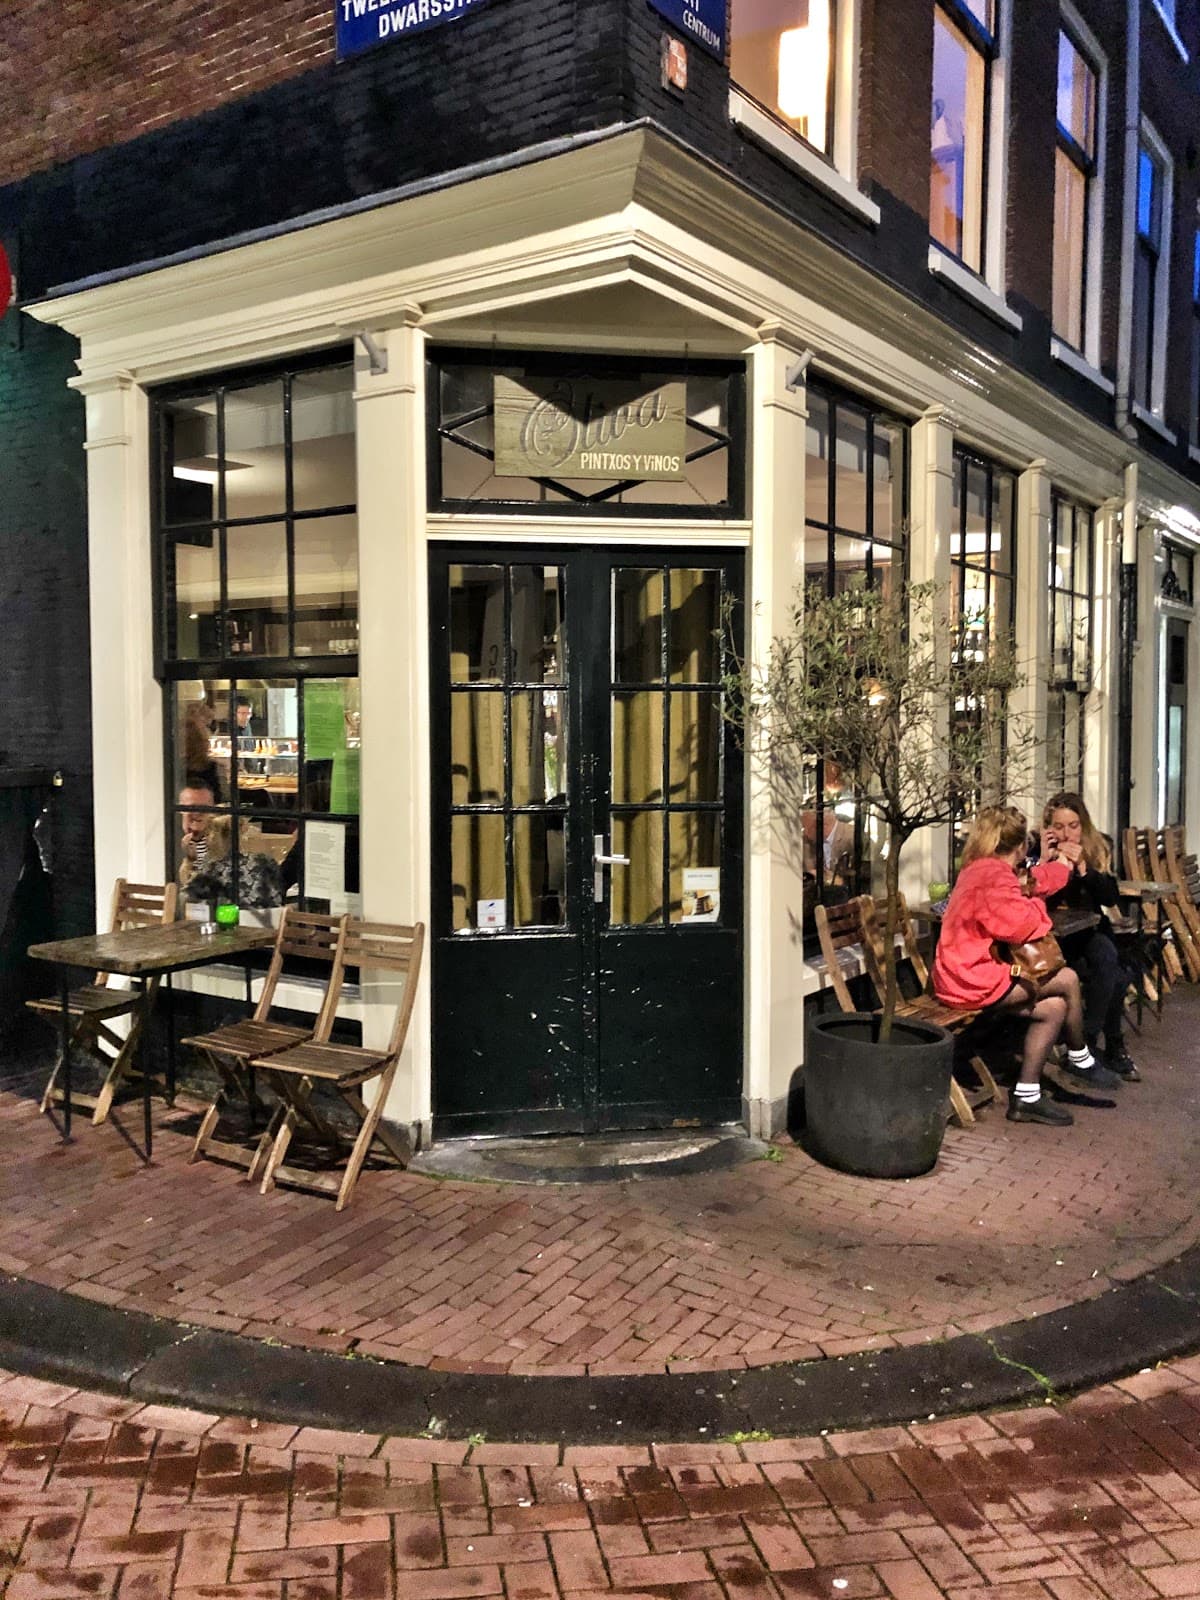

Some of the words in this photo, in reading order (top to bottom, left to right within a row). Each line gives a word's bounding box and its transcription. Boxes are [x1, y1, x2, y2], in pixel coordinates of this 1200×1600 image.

[341, 0, 397, 21] TWE
[378, 0, 471, 37] DWARSS
[682, 9, 721, 51] CENTRUM
[580, 452, 632, 471] PINTXOS
[633, 454, 642, 471] Y
